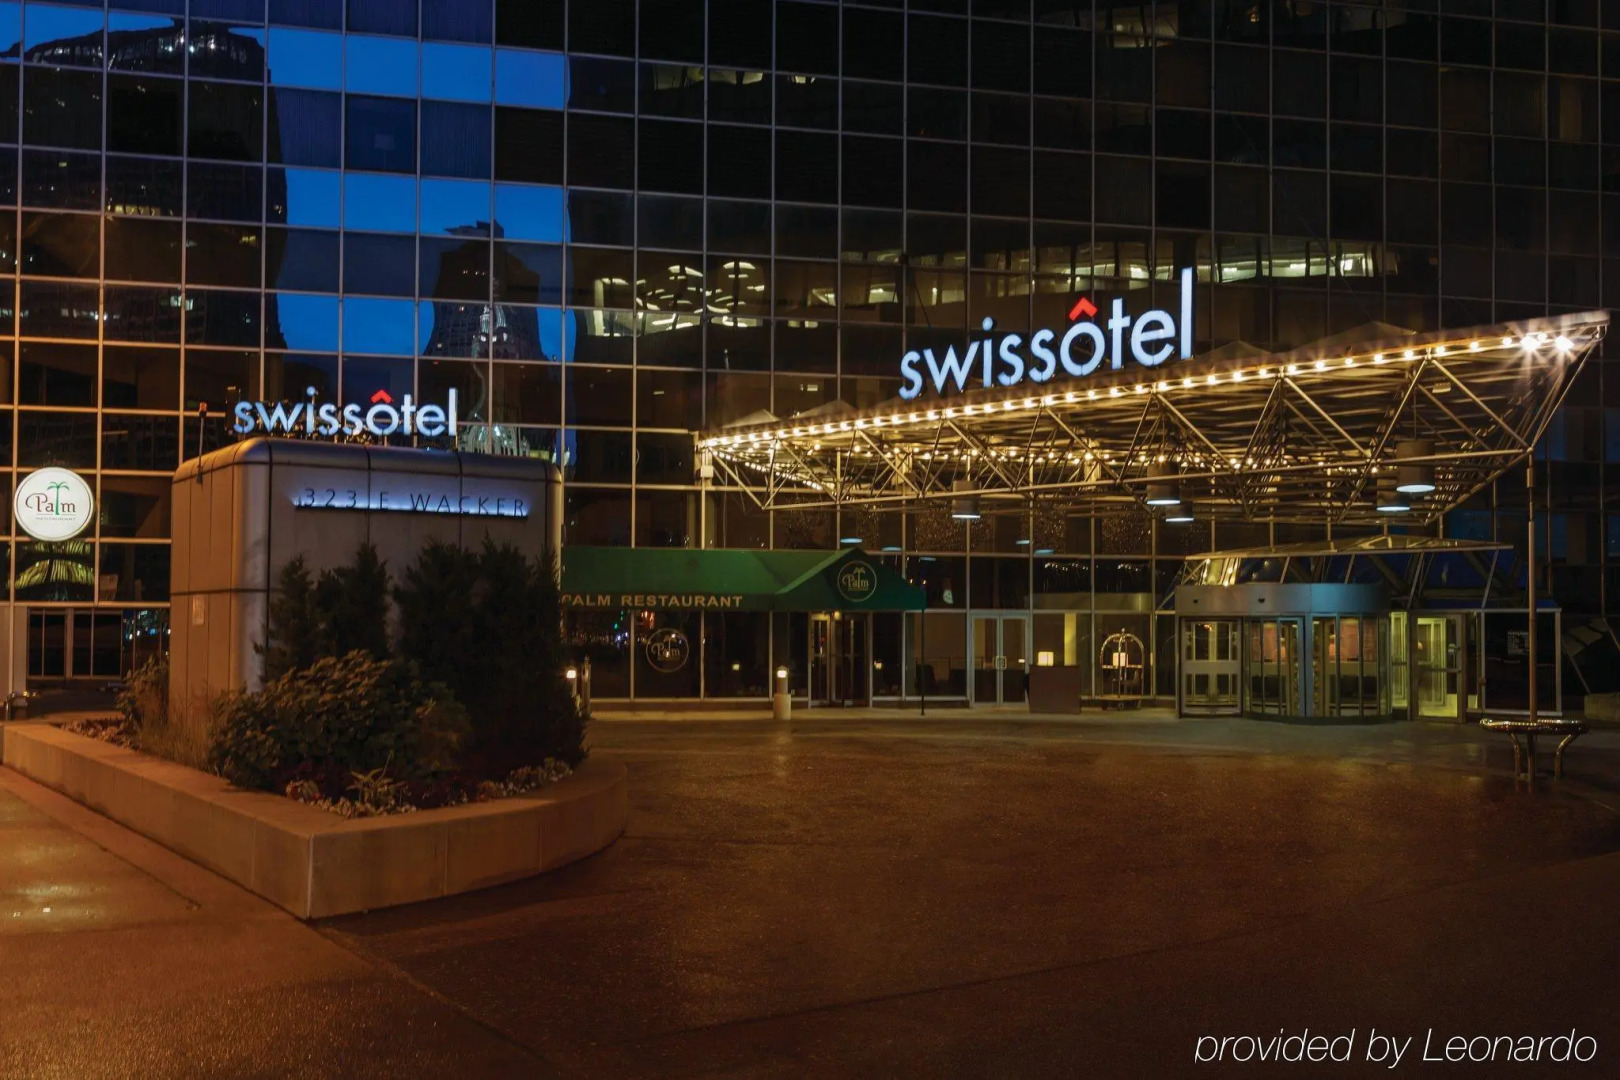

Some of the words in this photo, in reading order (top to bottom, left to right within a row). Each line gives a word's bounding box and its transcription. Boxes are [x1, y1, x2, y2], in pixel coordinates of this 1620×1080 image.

[25, 481, 77, 516] Palm
[304, 487, 357, 509] 323
[379, 491, 390, 511] E
[410, 493, 525, 517] WACKER
[841, 567, 870, 589] Palm
[561, 594, 612, 607] PALM
[621, 594, 743, 608] RESTAURANT
